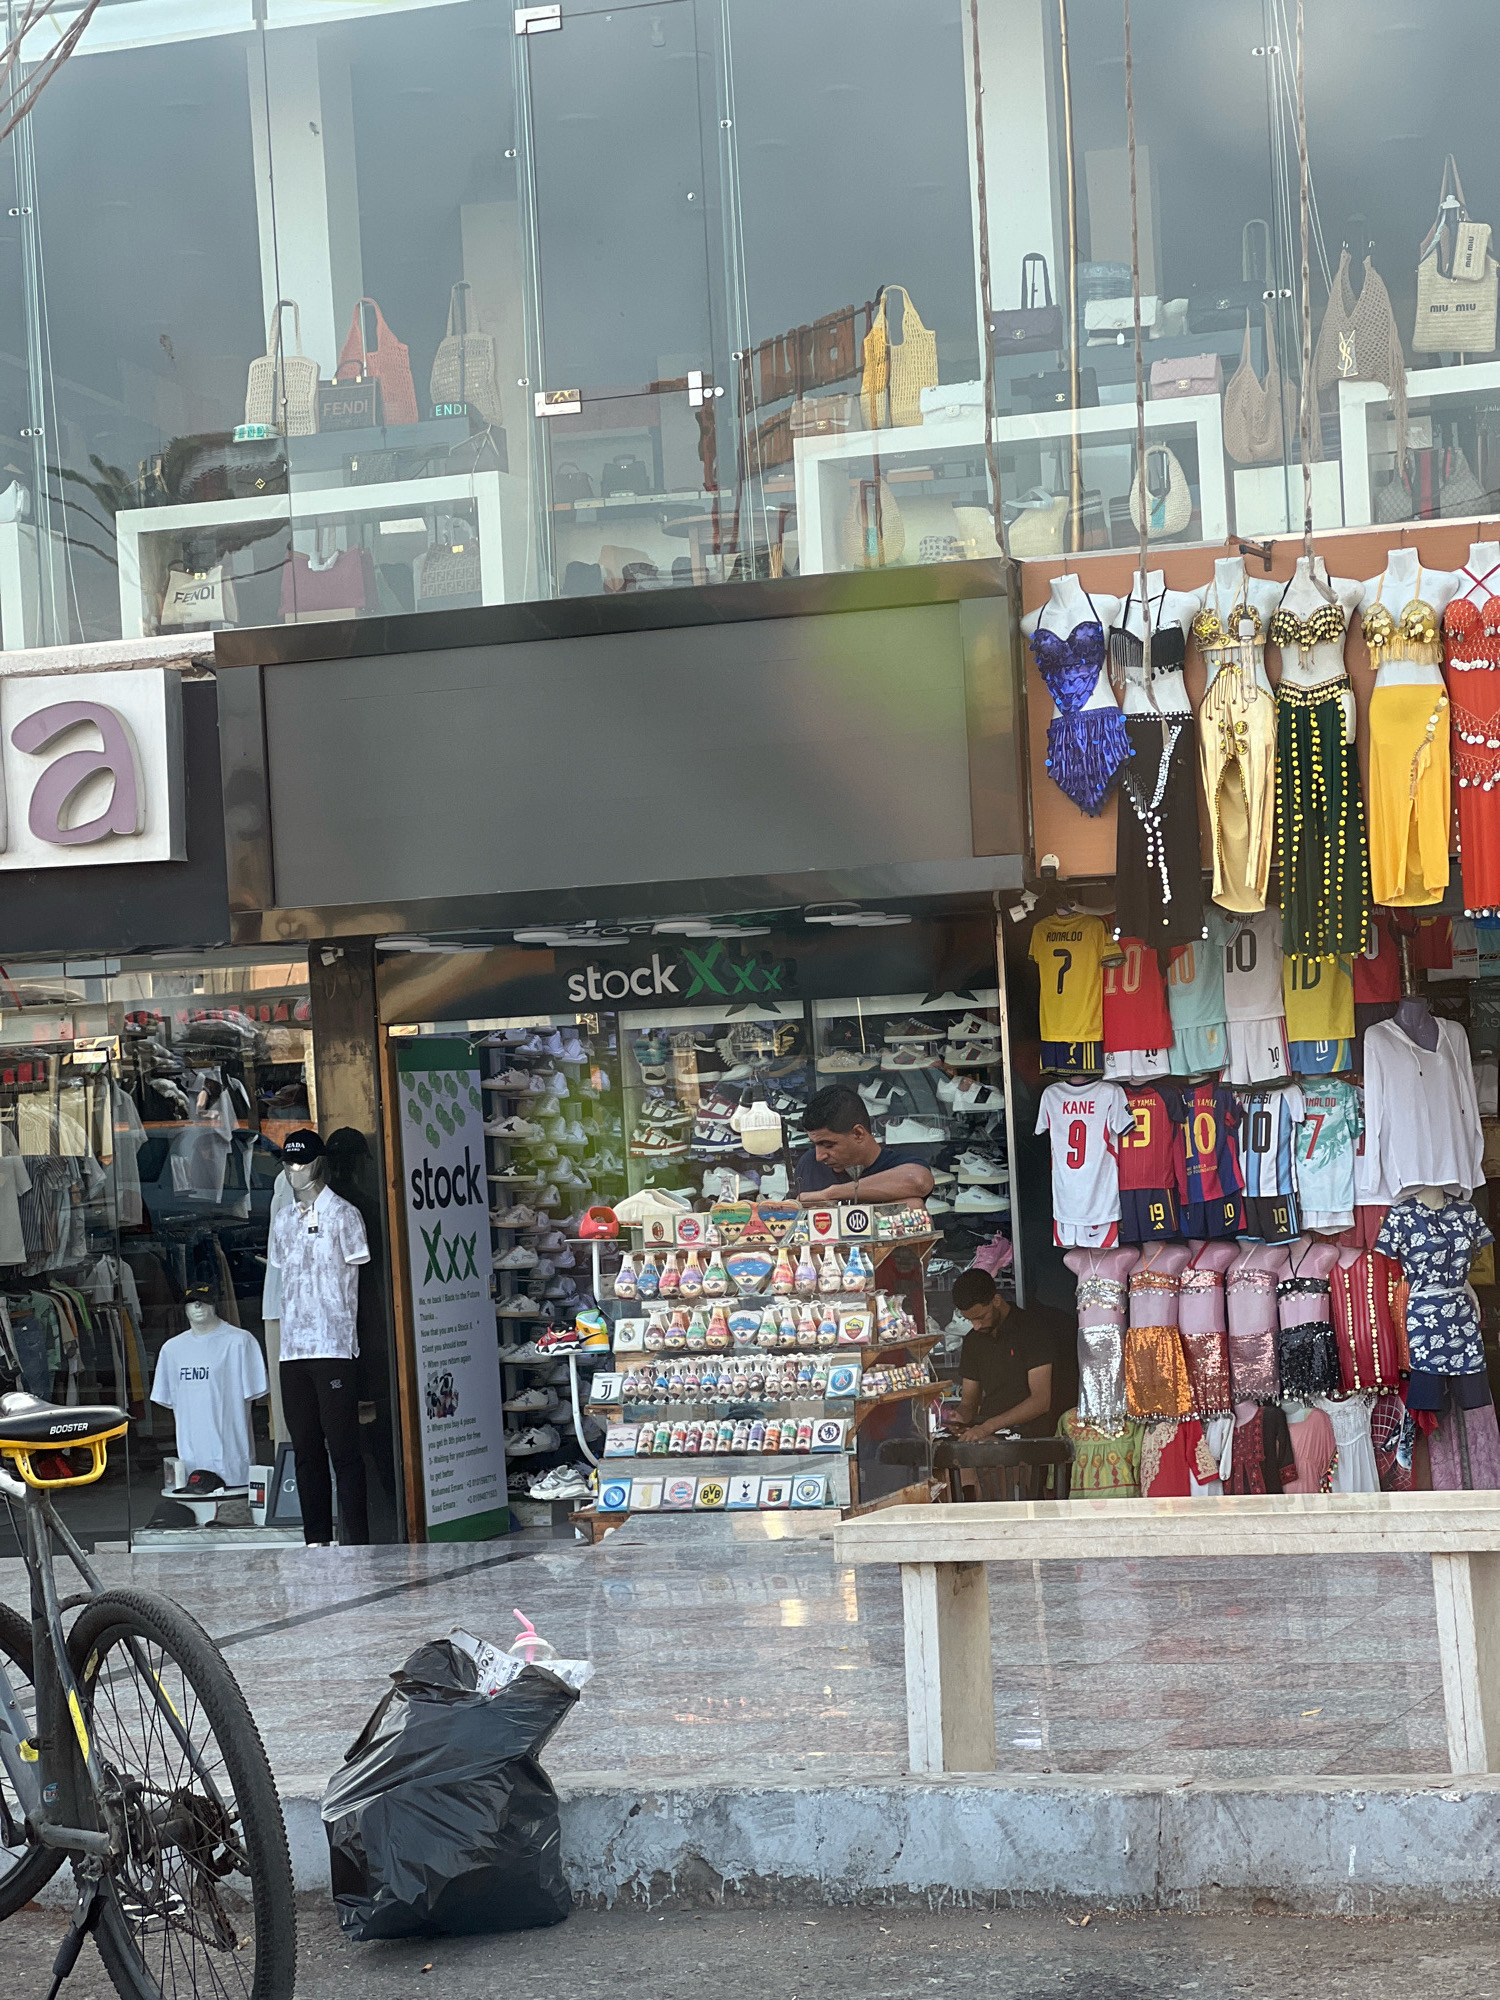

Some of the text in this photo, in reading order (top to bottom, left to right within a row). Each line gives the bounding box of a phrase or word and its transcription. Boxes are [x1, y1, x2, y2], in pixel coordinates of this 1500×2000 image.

[322, 400, 368, 417] FENDI
[435, 403, 467, 416] ENDI
[173, 585, 215, 604] FENDI
[0, 700, 147, 846] a
[1046, 931, 1083, 942] RONALDO
[1226, 928, 1257, 973] 10
[567, 953, 680, 1003] stock
[1052, 948, 1073, 995] 7
[1062, 1100, 1096, 1115] KANE
[1137, 1098, 1157, 1107] YAMAL
[1243, 1093, 1272, 1105] MESSI
[1305, 1097, 1337, 1108] ONALDO
[1180, 1112, 1217, 1159] 10
[1241, 1111, 1273, 1154] 10
[1305, 1113, 1325, 1160] 7
[1066, 1119, 1087, 1170] 9
[411, 1145, 484, 1211] stock
[1148, 1203, 1165, 1222] 19
[1223, 1202, 1235, 1219] 10
[1273, 1207, 1288, 1225] 10
[467, 1290, 480, 1299] Future
[422, 1339, 468, 1353] Client you should know
[460, 1354, 472, 1364] again
[49, 1422, 89, 1435] BOOSTER
[702, 1483, 721, 1498] BVB
